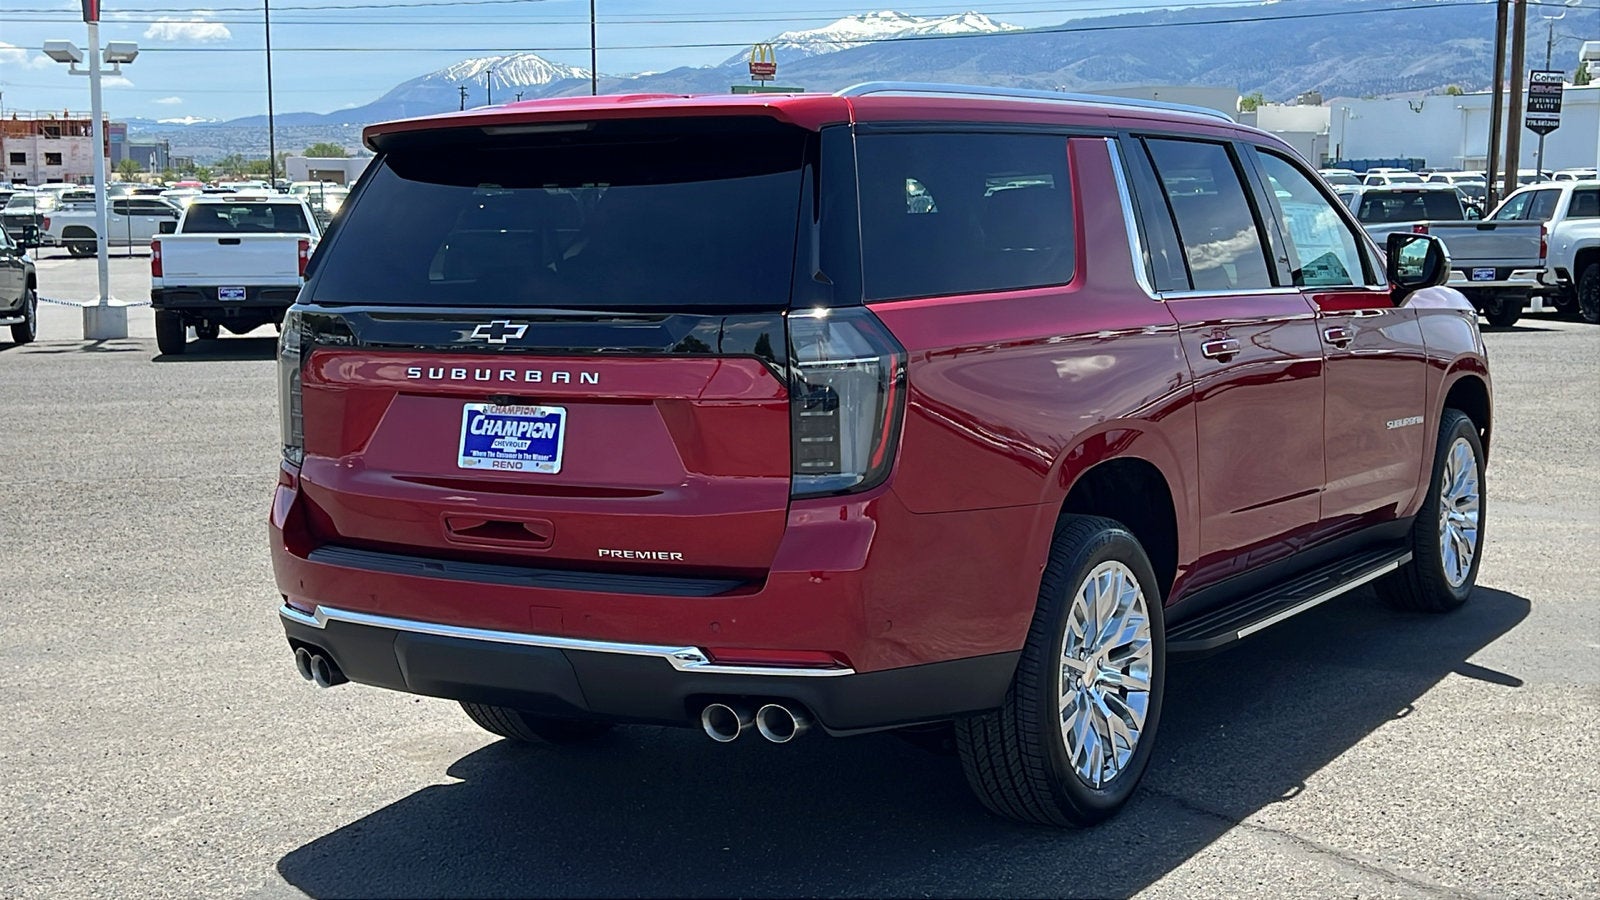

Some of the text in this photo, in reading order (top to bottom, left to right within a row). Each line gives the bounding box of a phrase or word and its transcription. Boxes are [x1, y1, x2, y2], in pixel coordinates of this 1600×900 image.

[1534, 73, 1564, 82] Corwin
[1531, 85, 1562, 93] GMC
[407, 367, 599, 384] SUBURBAN
[490, 405, 538, 415] CHAMPION
[470, 414, 557, 439] CHAMPION
[1386, 415, 1424, 430] SUBURBAN
[494, 440, 528, 448] CHEVROLET
[492, 460, 523, 470] RENO
[598, 549, 684, 561] PREMIER
